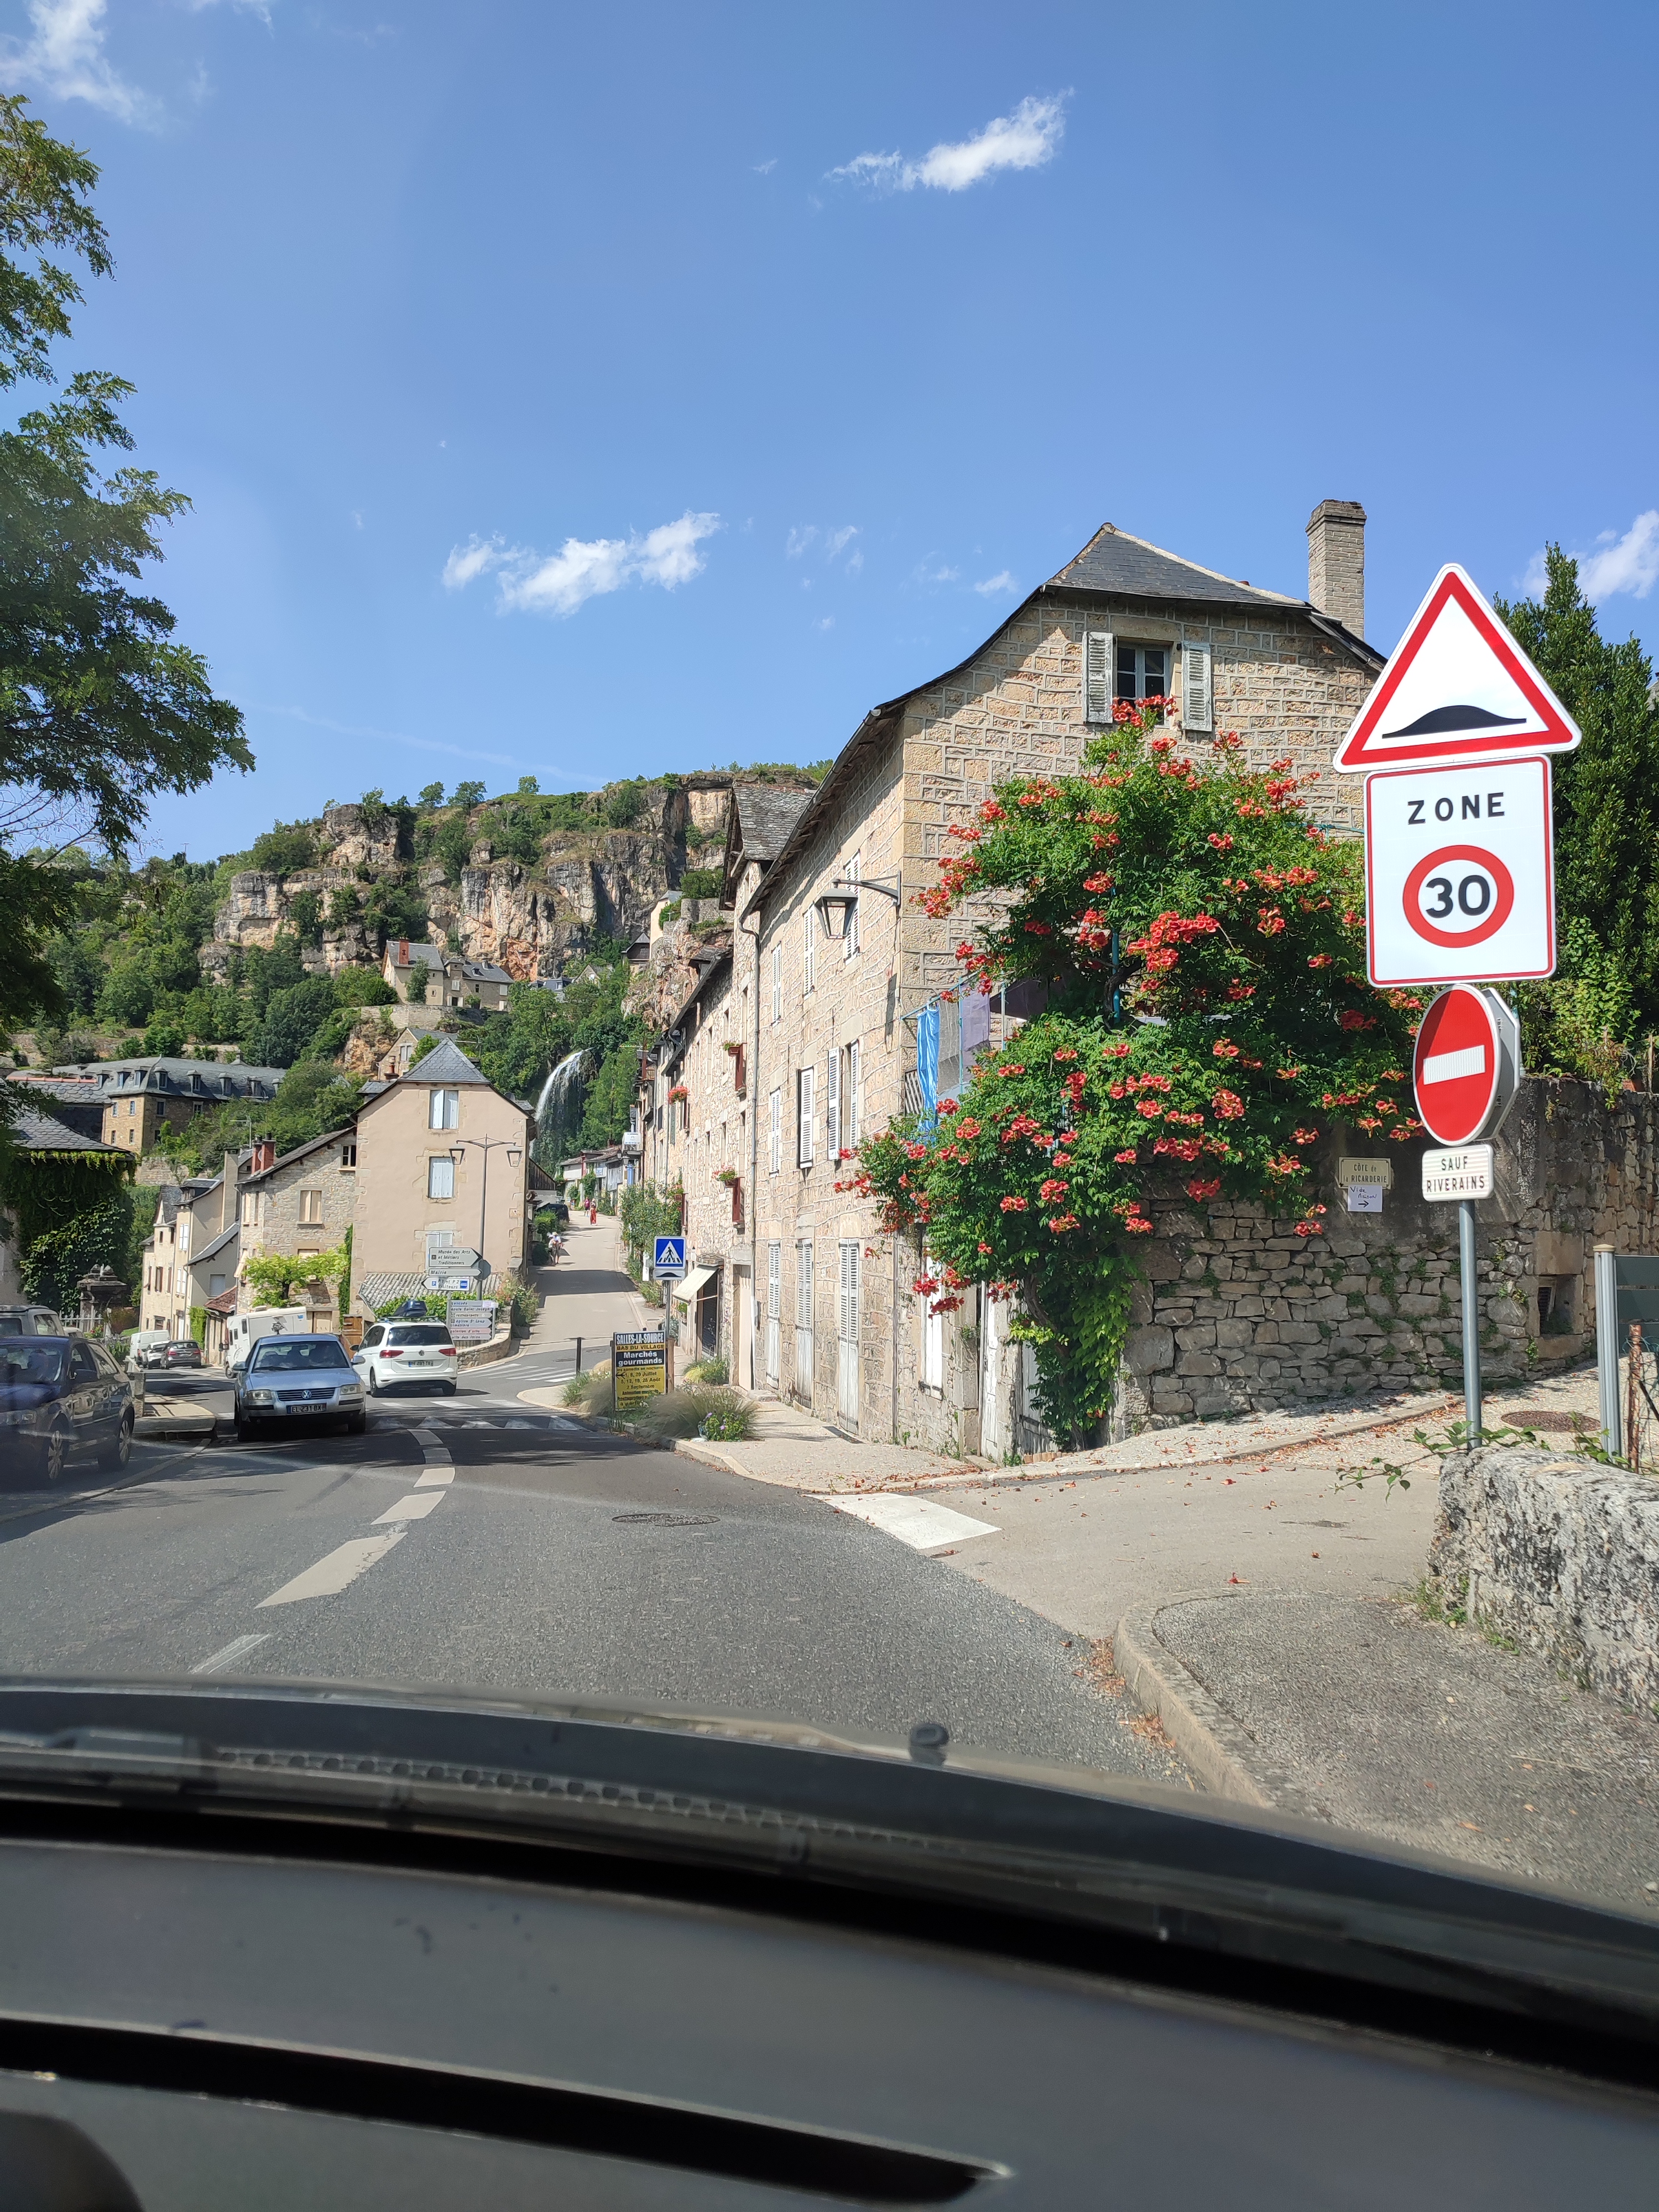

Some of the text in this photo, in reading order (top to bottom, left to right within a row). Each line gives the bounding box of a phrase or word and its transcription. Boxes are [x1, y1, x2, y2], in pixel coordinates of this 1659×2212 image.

[1407, 792, 1505, 825] ZONE
[1425, 874, 1490, 919] 30
[1354, 1163, 1368, 1172] CÔTE
[1441, 1156, 1468, 1171] SAUF
[1426, 1175, 1485, 1192] RIVERAINS
[617, 1333, 663, 1344] SALLES-LA-SOURCE
[618, 1358, 662, 1367] gourmands
